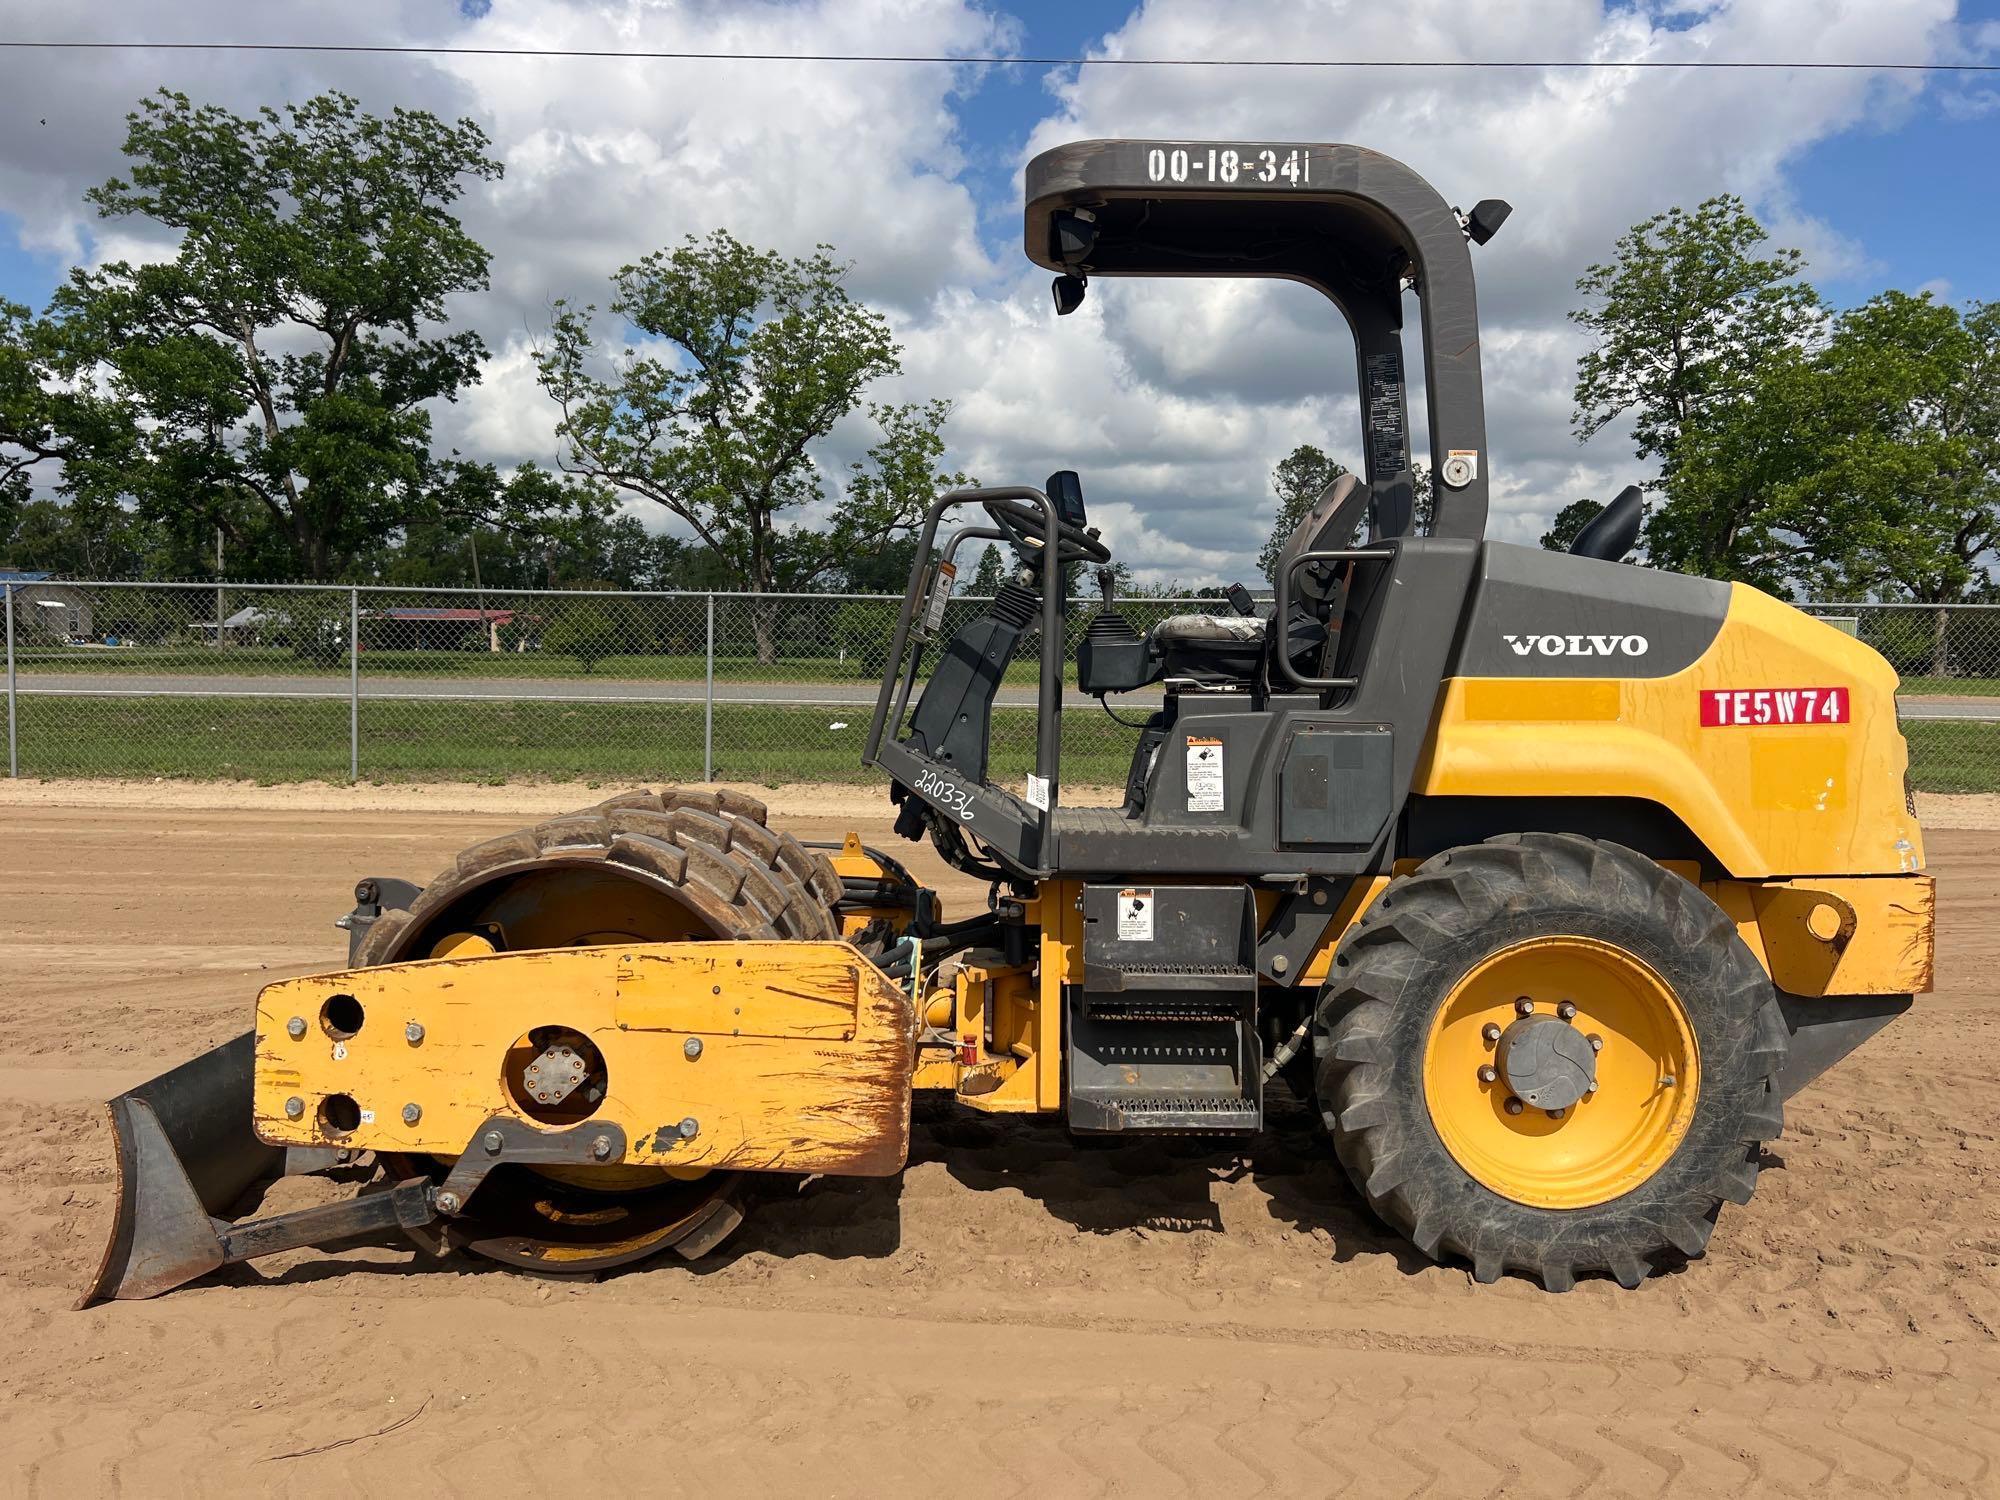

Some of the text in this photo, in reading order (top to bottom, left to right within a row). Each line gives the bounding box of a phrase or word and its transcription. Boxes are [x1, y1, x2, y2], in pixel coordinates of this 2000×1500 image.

[1503, 635, 1649, 656] VOLVO
[1714, 691, 1840, 724] TE5W74
[914, 769, 975, 820] 220336
